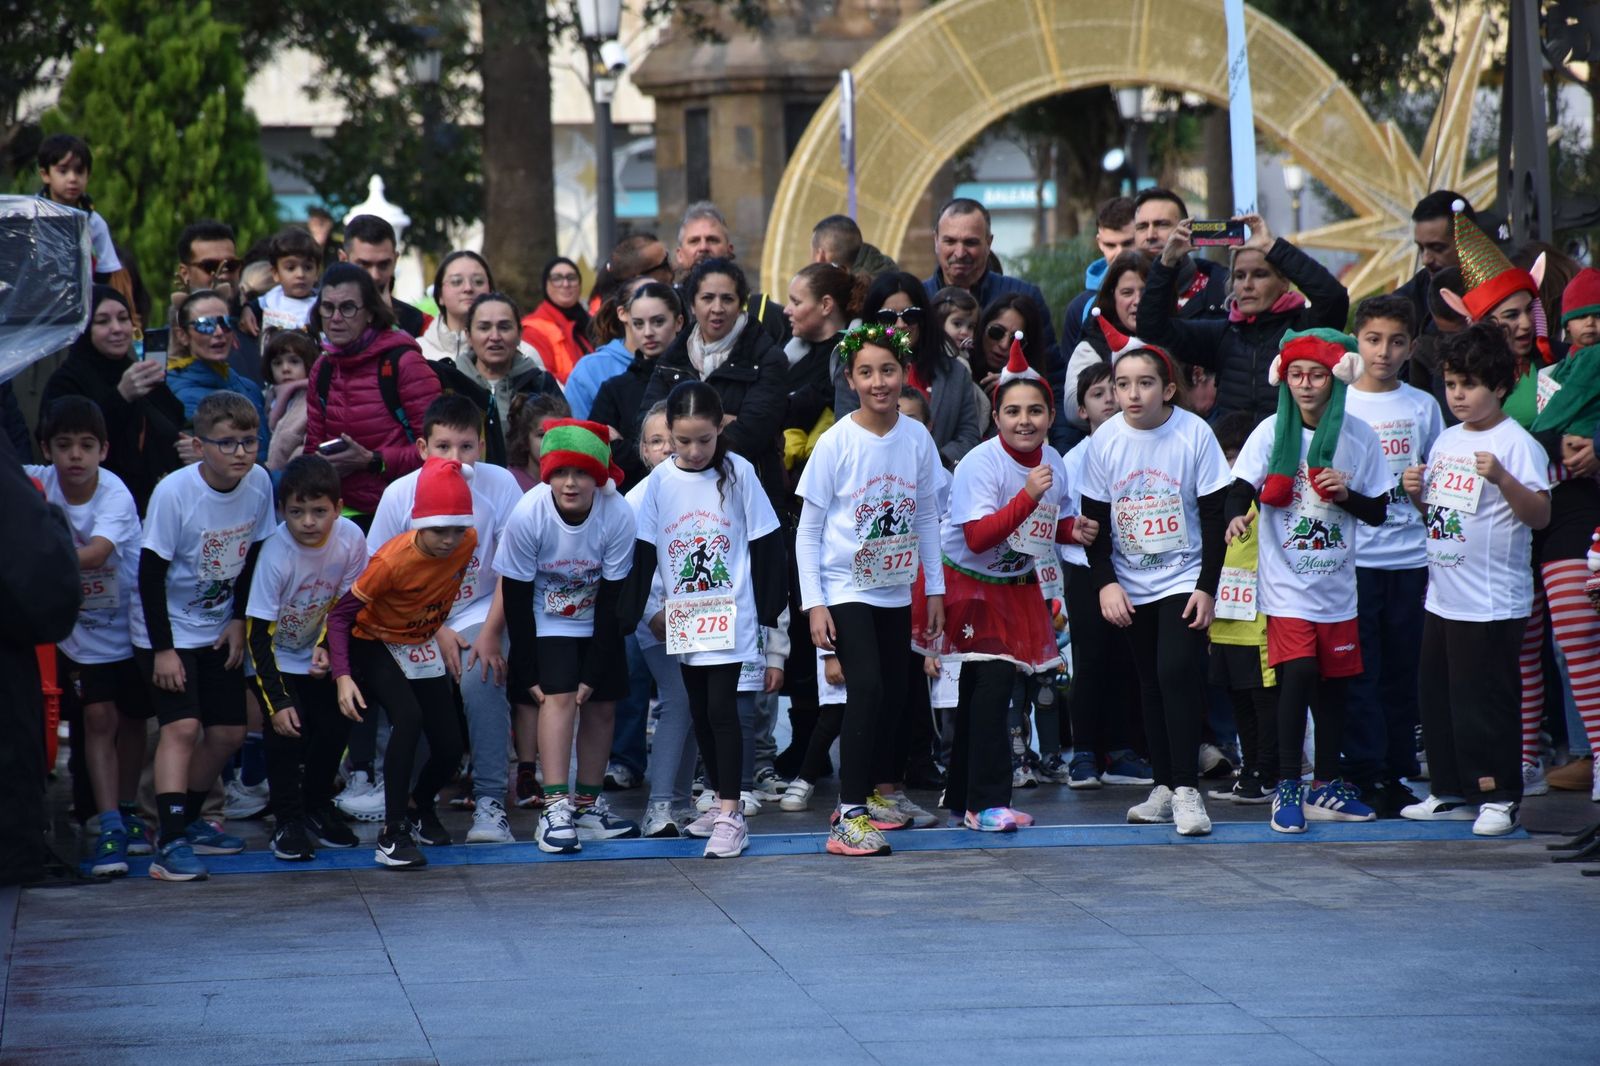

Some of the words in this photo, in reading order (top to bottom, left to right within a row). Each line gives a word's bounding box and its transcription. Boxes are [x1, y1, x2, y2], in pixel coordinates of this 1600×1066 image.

[1444, 473, 1475, 493] 214
[1029, 521, 1053, 540] 292
[1142, 515, 1179, 536] 216
[882, 551, 913, 571] 372
[1296, 555, 1338, 570] Marcos
[1039, 566, 1057, 584] 08
[1221, 586, 1253, 604] 616
[696, 615, 729, 635] 278
[409, 645, 436, 663] 615
